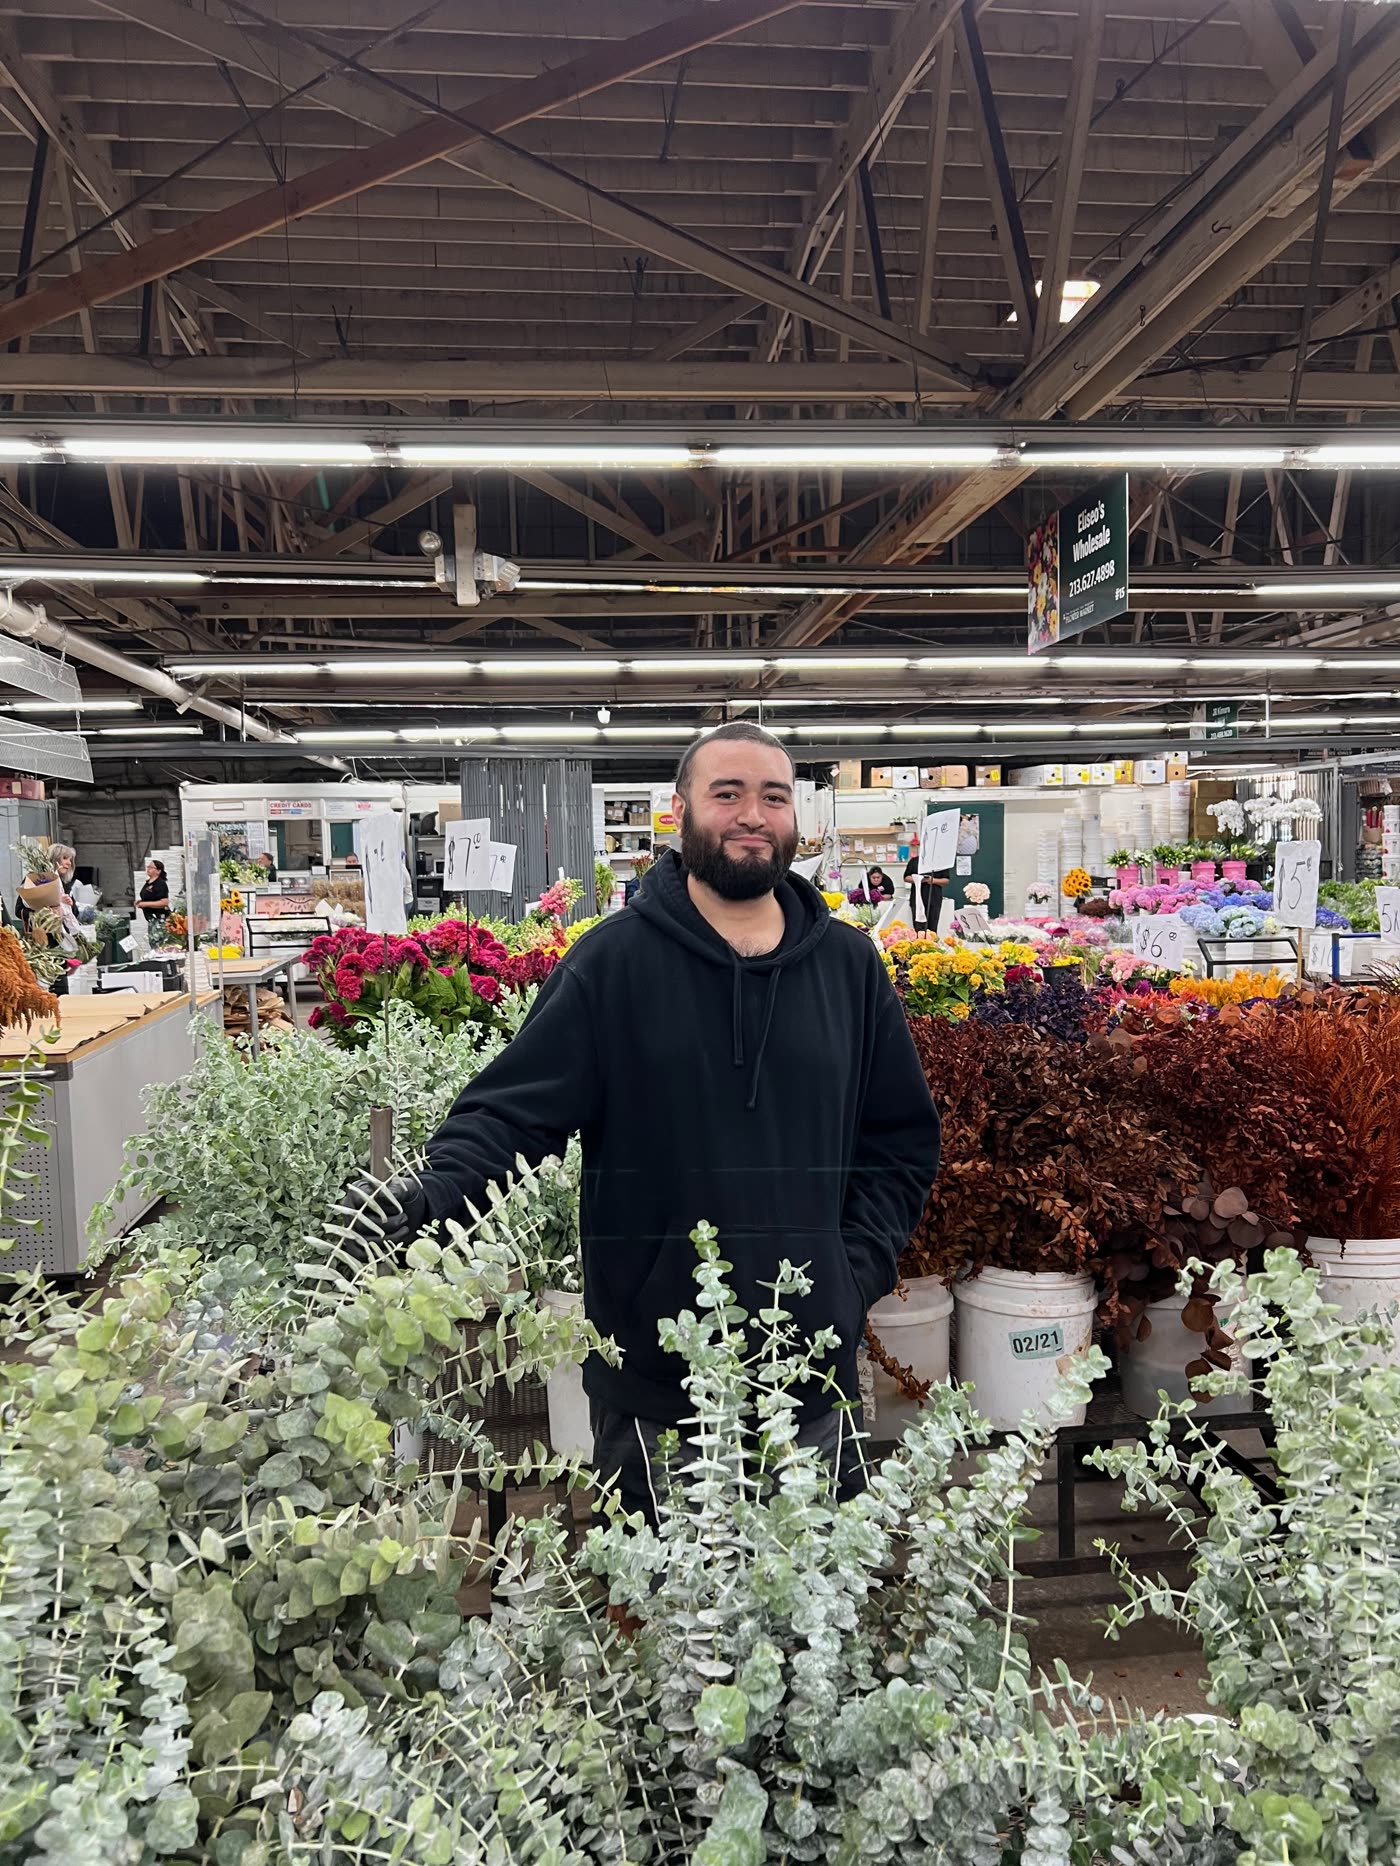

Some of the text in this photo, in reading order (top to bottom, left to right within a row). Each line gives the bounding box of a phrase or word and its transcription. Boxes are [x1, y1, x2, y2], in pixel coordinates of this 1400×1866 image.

[1078, 500, 1105, 533] Eliseo's
[1072, 525, 1111, 563] Wholesale
[1068, 560, 1115, 598] 213.627.4898
[1114, 586, 1126, 601] #15
[1012, 1330, 1059, 1354] 02/21
